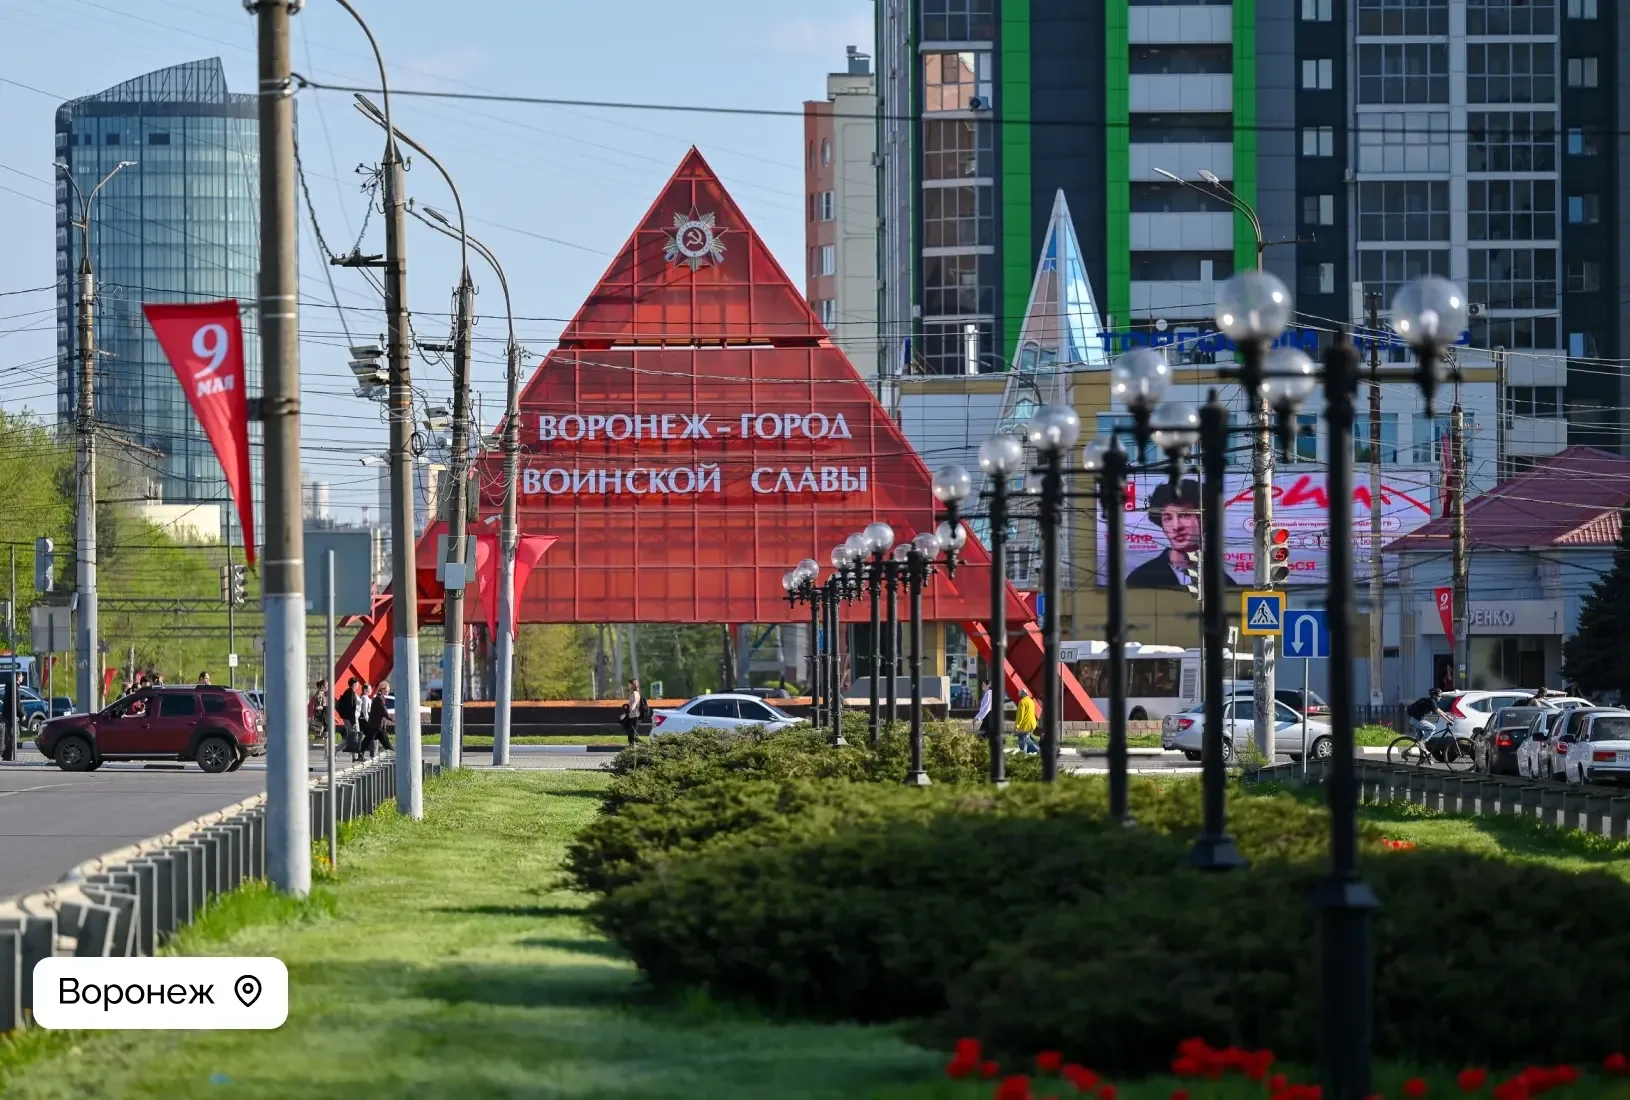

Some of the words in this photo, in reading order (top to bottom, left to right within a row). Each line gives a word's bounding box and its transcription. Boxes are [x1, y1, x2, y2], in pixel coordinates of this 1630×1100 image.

[192, 323, 229, 379] 9
[197, 375, 235, 398] МАЯ
[539, 414, 712, 441] ВОРОНЕЖ
[741, 413, 852, 440] ГОРОД
[523, 462, 721, 495] ВОИНСКОЙ
[751, 466, 867, 493] СЛАВЫ
[1440, 592, 1448, 606] 9
